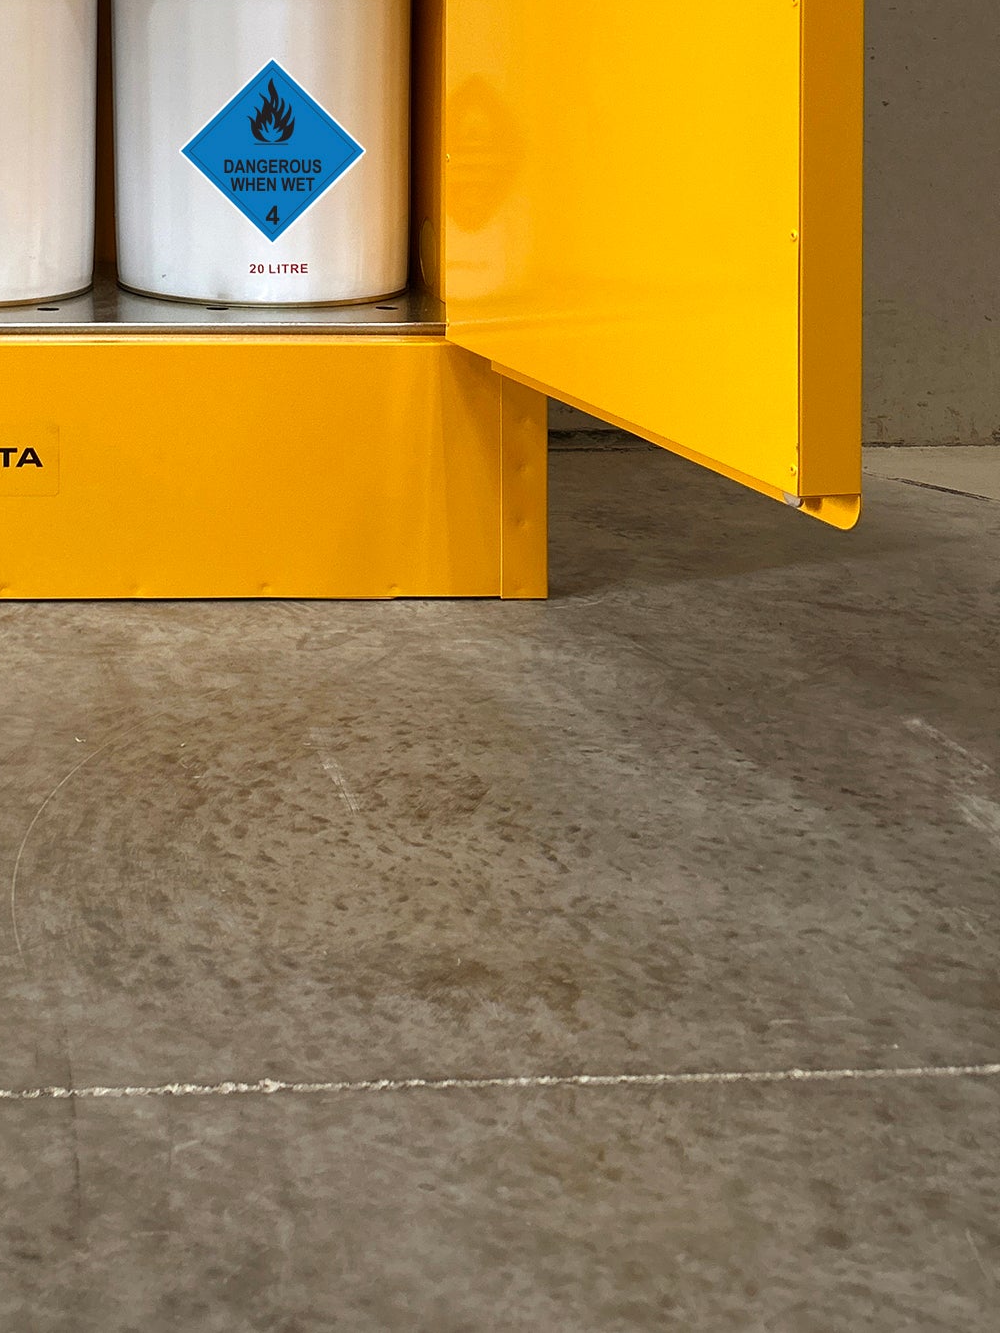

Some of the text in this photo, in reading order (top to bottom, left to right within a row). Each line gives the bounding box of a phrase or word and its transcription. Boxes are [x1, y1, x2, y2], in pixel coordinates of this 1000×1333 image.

[223, 159, 322, 174] DANGEROUS
[231, 177, 315, 191] WHEN WET
[266, 205, 280, 225] 4
[249, 263, 309, 274] 20 LITRE
